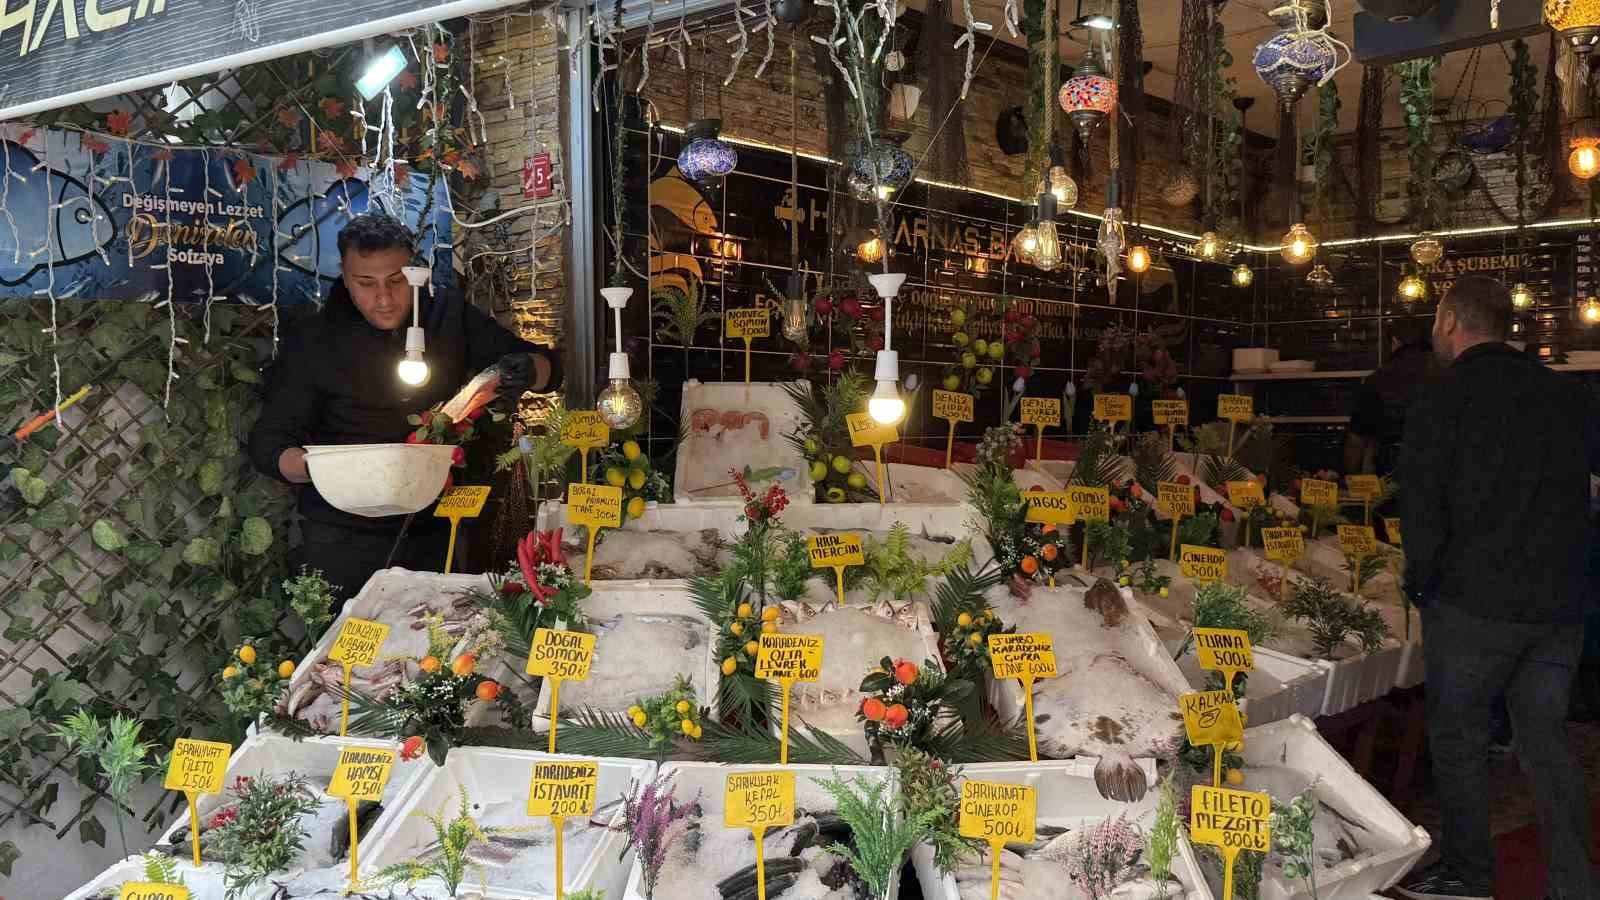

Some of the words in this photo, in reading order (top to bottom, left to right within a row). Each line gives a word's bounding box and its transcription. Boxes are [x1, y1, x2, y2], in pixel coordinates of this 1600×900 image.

[536, 168, 544, 185] 5
[122, 193, 215, 215] Değişmeyen
[218, 201, 264, 218] Lezzet
[169, 247, 225, 266] Sofraya
[1195, 633, 1244, 649] TURNA
[535, 644, 590, 663] SOMON
[759, 659, 807, 670] LEVREK
[533, 780, 595, 801] İSTAVRİT
[745, 787, 781, 807] KEFAL
[964, 781, 1031, 801] SARIKANAT
[1195, 812, 1265, 835] MEZGİT
